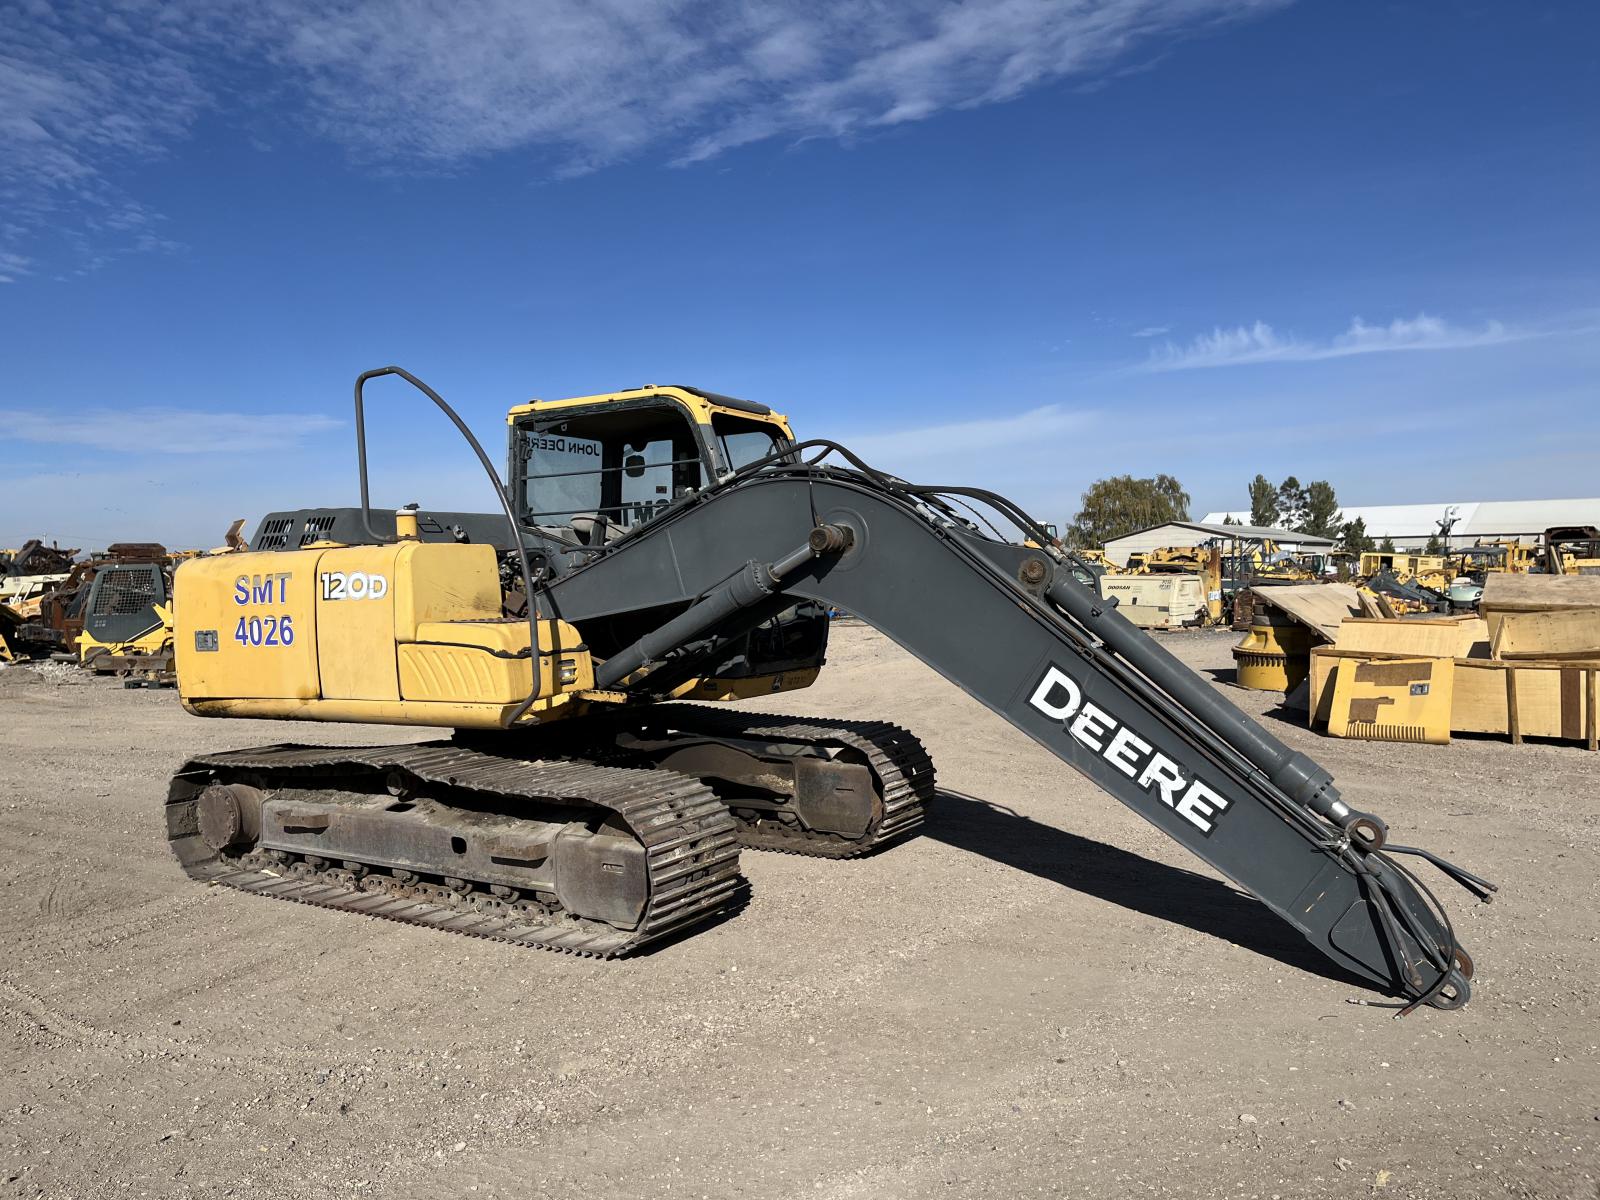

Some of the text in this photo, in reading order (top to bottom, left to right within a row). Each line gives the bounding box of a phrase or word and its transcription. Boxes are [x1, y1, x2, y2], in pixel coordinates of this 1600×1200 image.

[234, 572, 292, 606] SMT
[320, 571, 388, 601] 120D
[234, 614, 294, 647] 4026
[1028, 664, 1230, 834] DEERE
